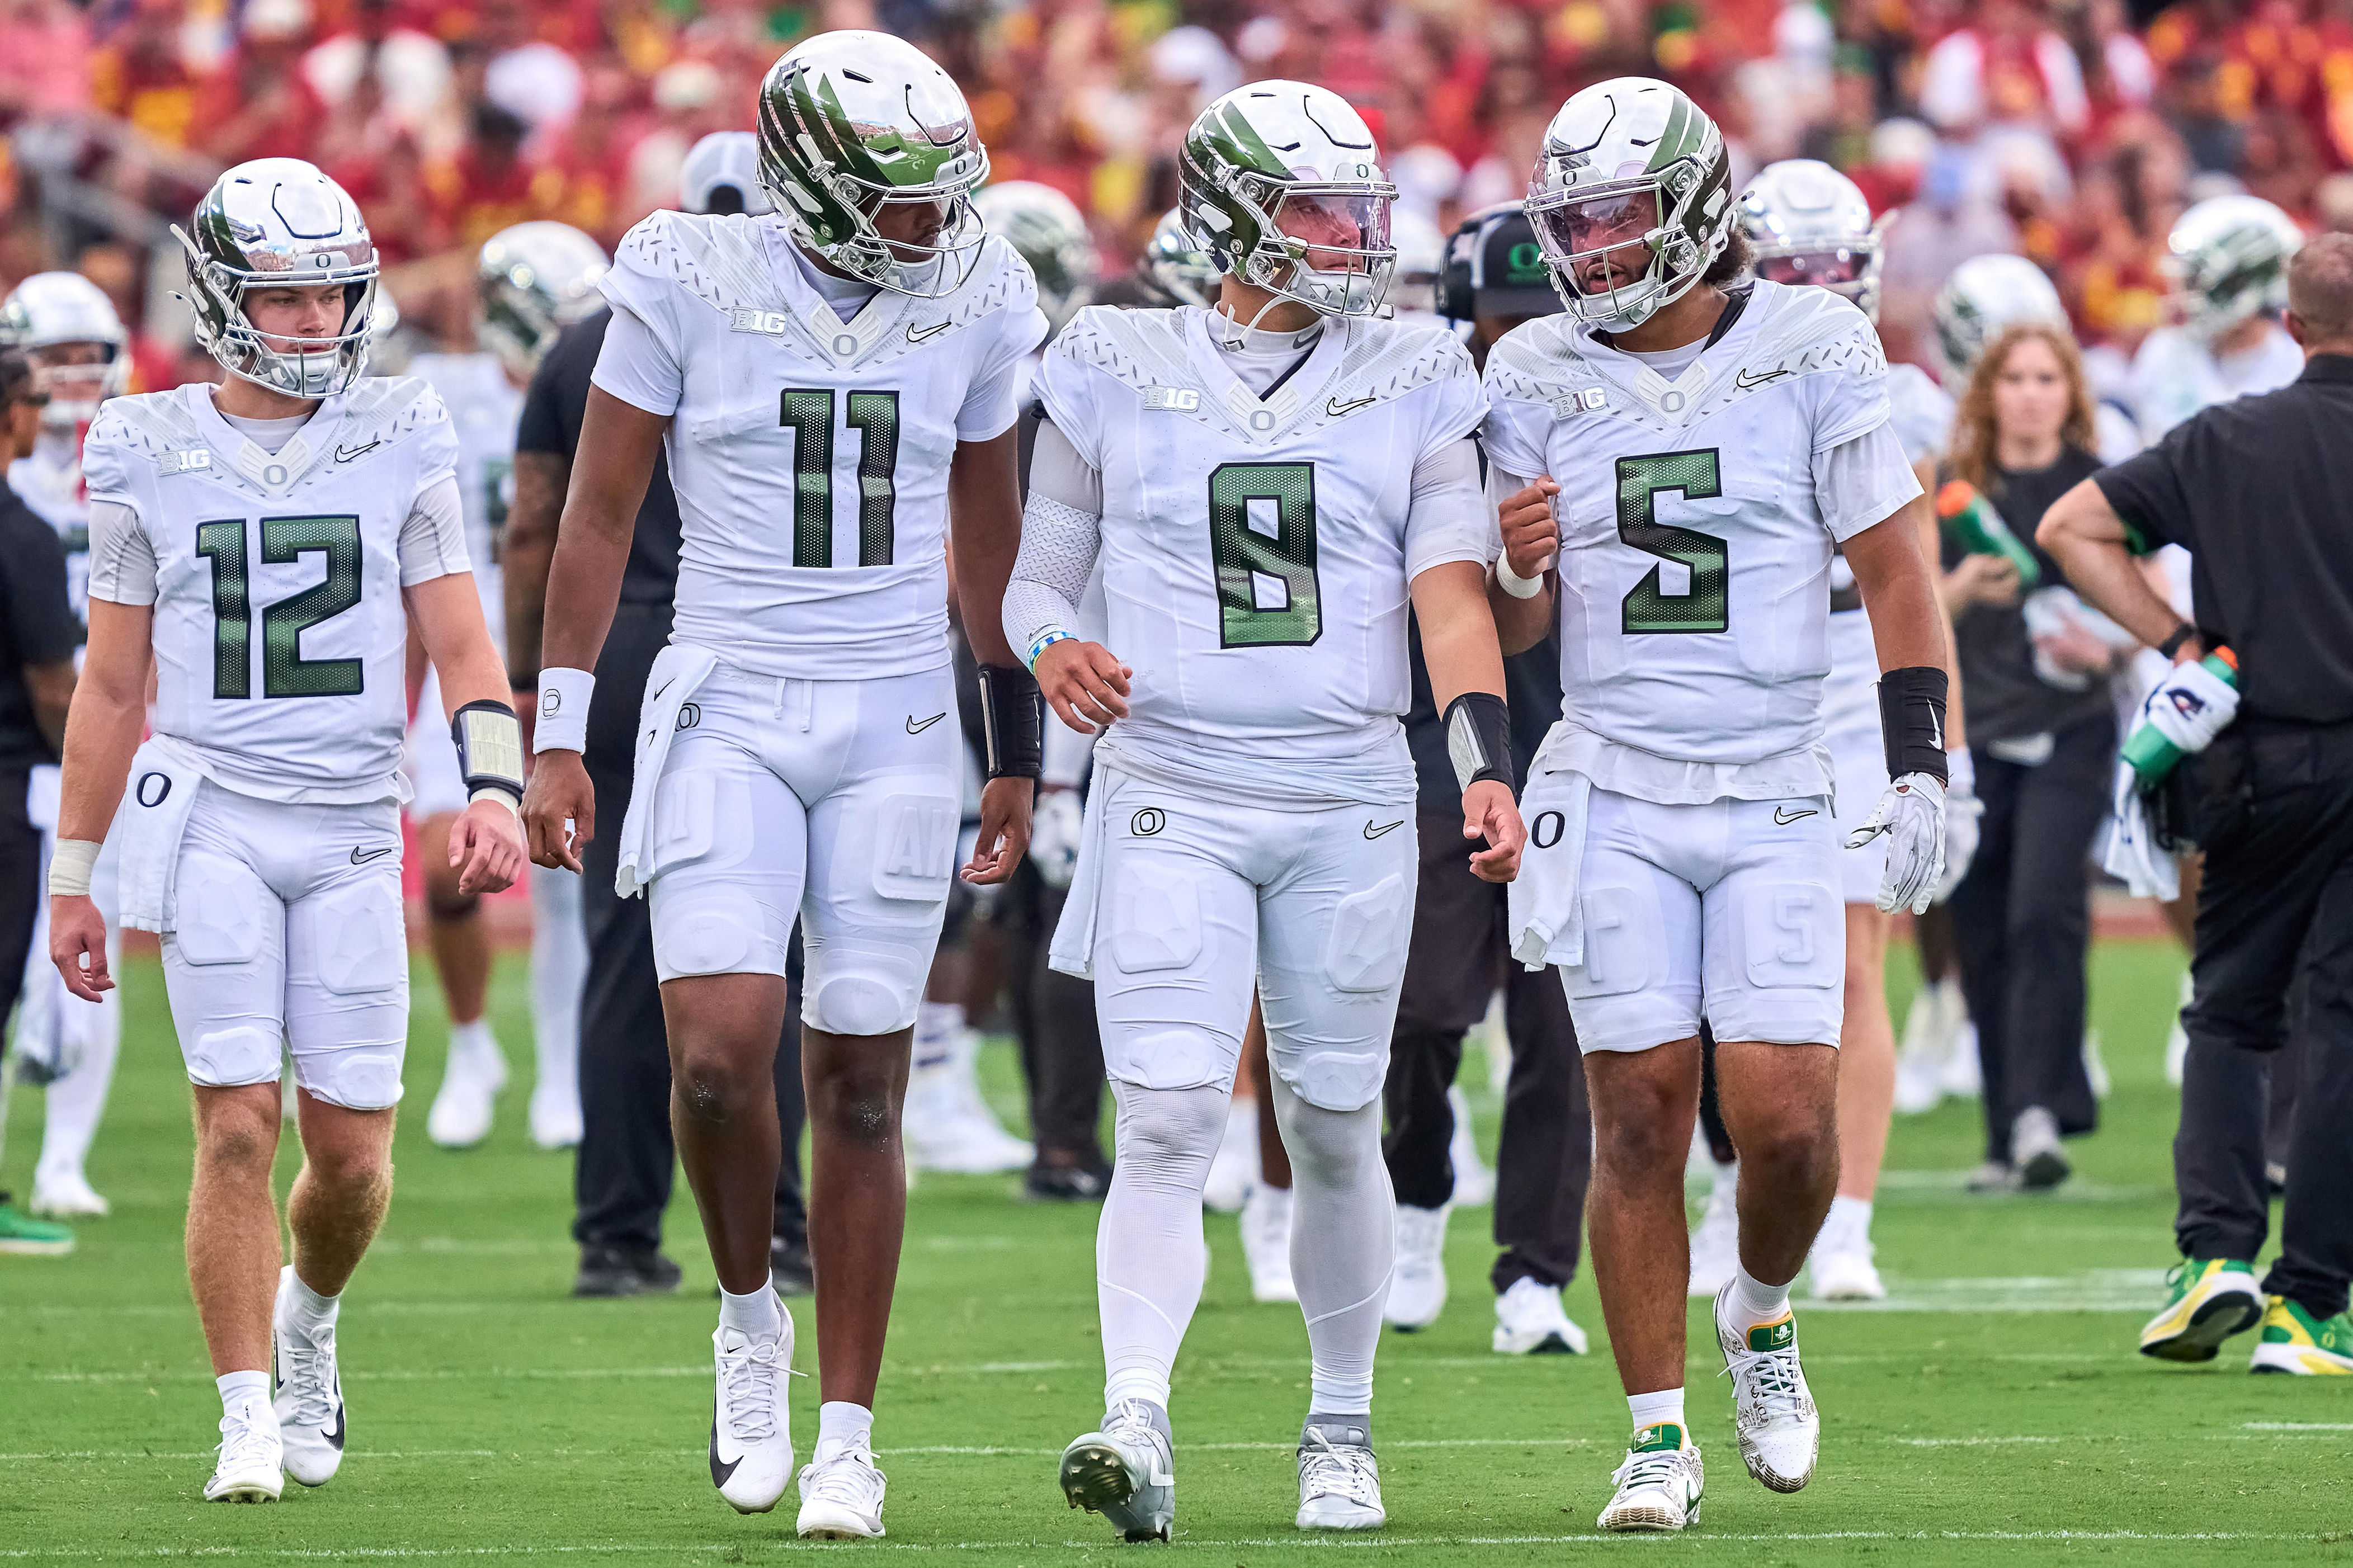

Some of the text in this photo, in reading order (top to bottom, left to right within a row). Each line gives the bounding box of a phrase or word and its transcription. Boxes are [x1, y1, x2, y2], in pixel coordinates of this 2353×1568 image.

[955, 159, 966, 174] O
[1356, 164, 1369, 178] O
[1562, 171, 1577, 186] O
[315, 253, 331, 268] O
[832, 334, 858, 356] O
[1661, 391, 1685, 412] O
[1249, 410, 1276, 431] O
[263, 464, 287, 485] O
[780, 388, 900, 568] 11
[1615, 447, 1729, 635] 5
[1208, 461, 1323, 649] 8
[196, 513, 364, 699] 12
[136, 772, 172, 807] O
[1131, 807, 1166, 835] O
[1531, 811, 1565, 849] O
[1774, 895, 1814, 963] 5
